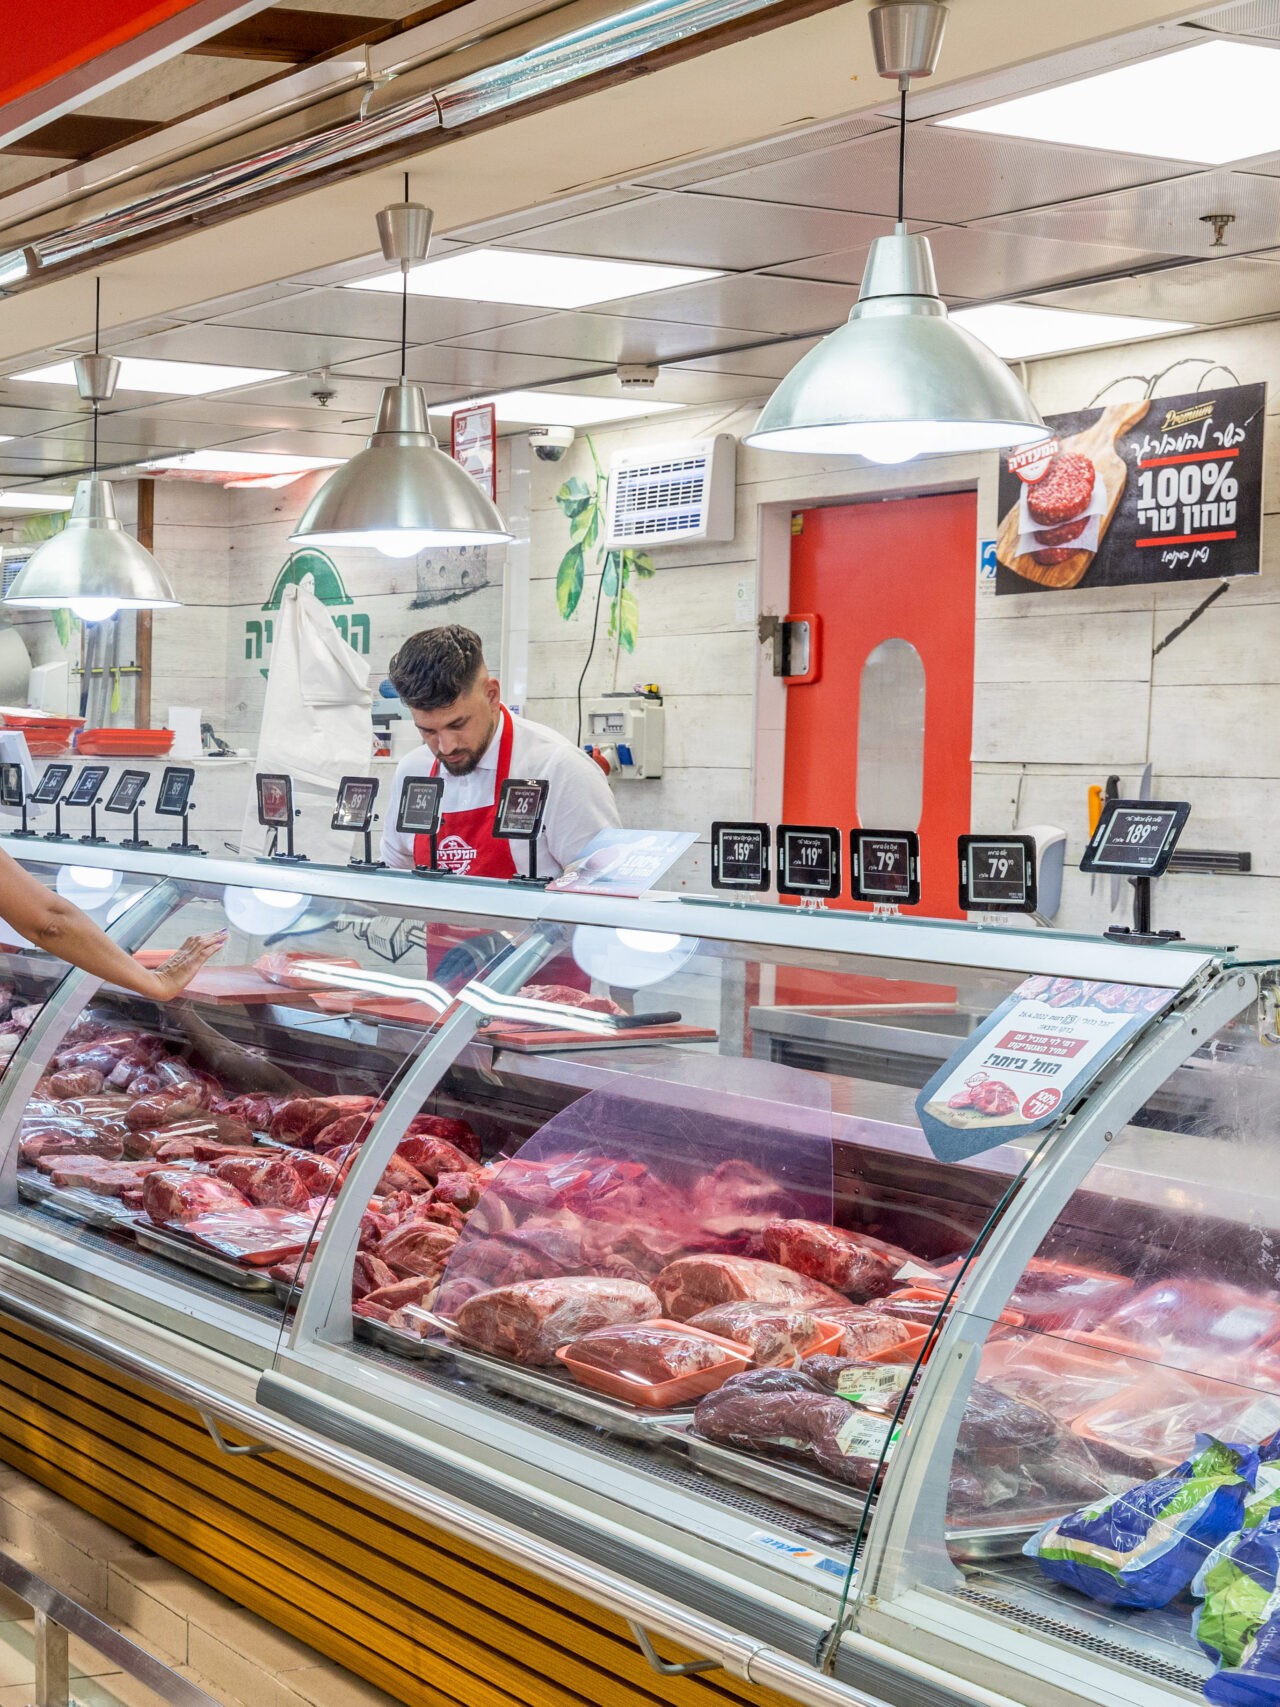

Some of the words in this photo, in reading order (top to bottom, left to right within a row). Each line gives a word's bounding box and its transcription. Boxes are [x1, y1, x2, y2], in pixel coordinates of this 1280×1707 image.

[1162, 402, 1215, 429] Premium
[1213, 422, 1246, 448] בשר
[1137, 461, 1239, 509] 100%
[1137, 507, 1177, 532] טרי
[1182, 501, 1237, 534] טחון
[436, 849, 477, 861] המעדני
[983, 1053, 1027, 1070] ביותר!
[1029, 1058, 1063, 1075] הזול
[1029, 1099, 1049, 1115] טרי
[1036, 1091, 1059, 1106] 100%
